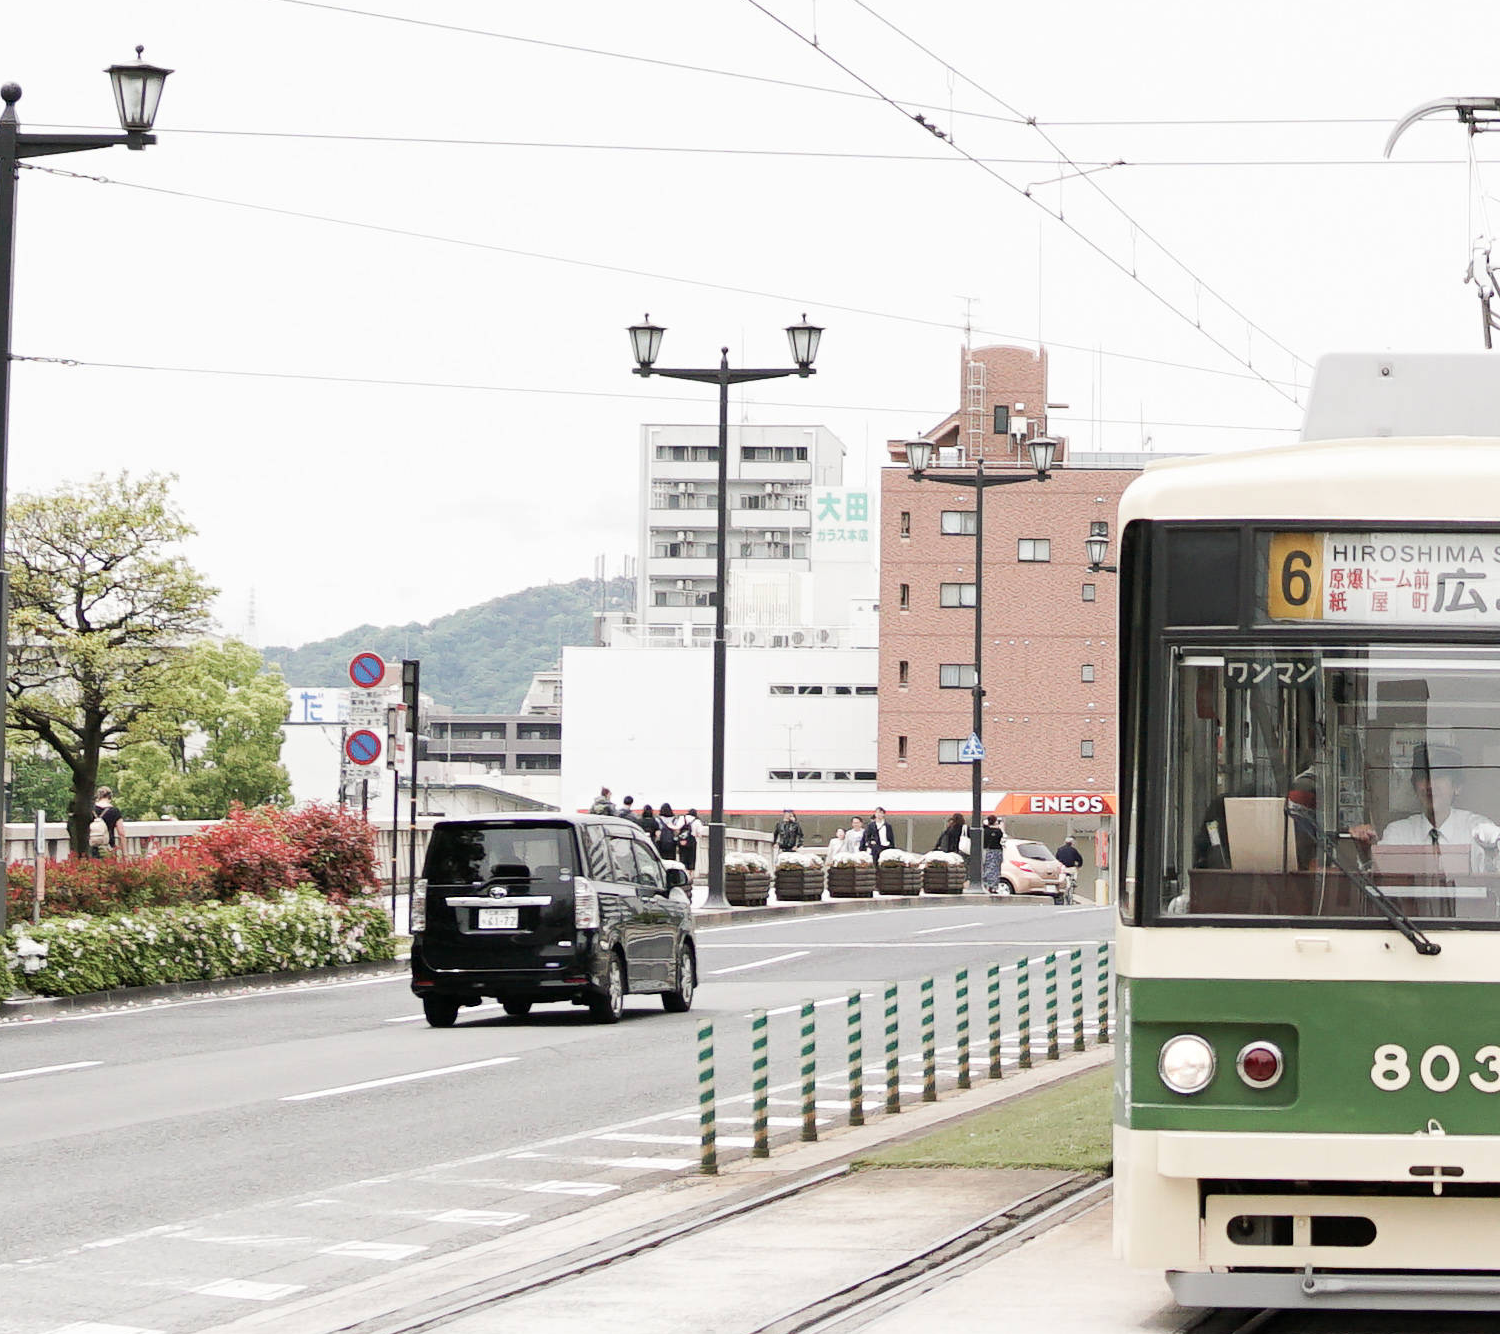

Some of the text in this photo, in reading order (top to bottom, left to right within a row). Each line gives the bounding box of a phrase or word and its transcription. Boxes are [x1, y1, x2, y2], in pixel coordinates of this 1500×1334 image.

[817, 492, 868, 521] 大田
[816, 528, 869, 542] ガラス本店
[1333, 544, 1484, 564] HIROSHIMA
[1281, 550, 1312, 606] 6
[1328, 568, 1430, 590] 原爆ドーム前
[1227, 661, 1316, 684] ワンマン
[1030, 796, 1104, 813] ENEOS
